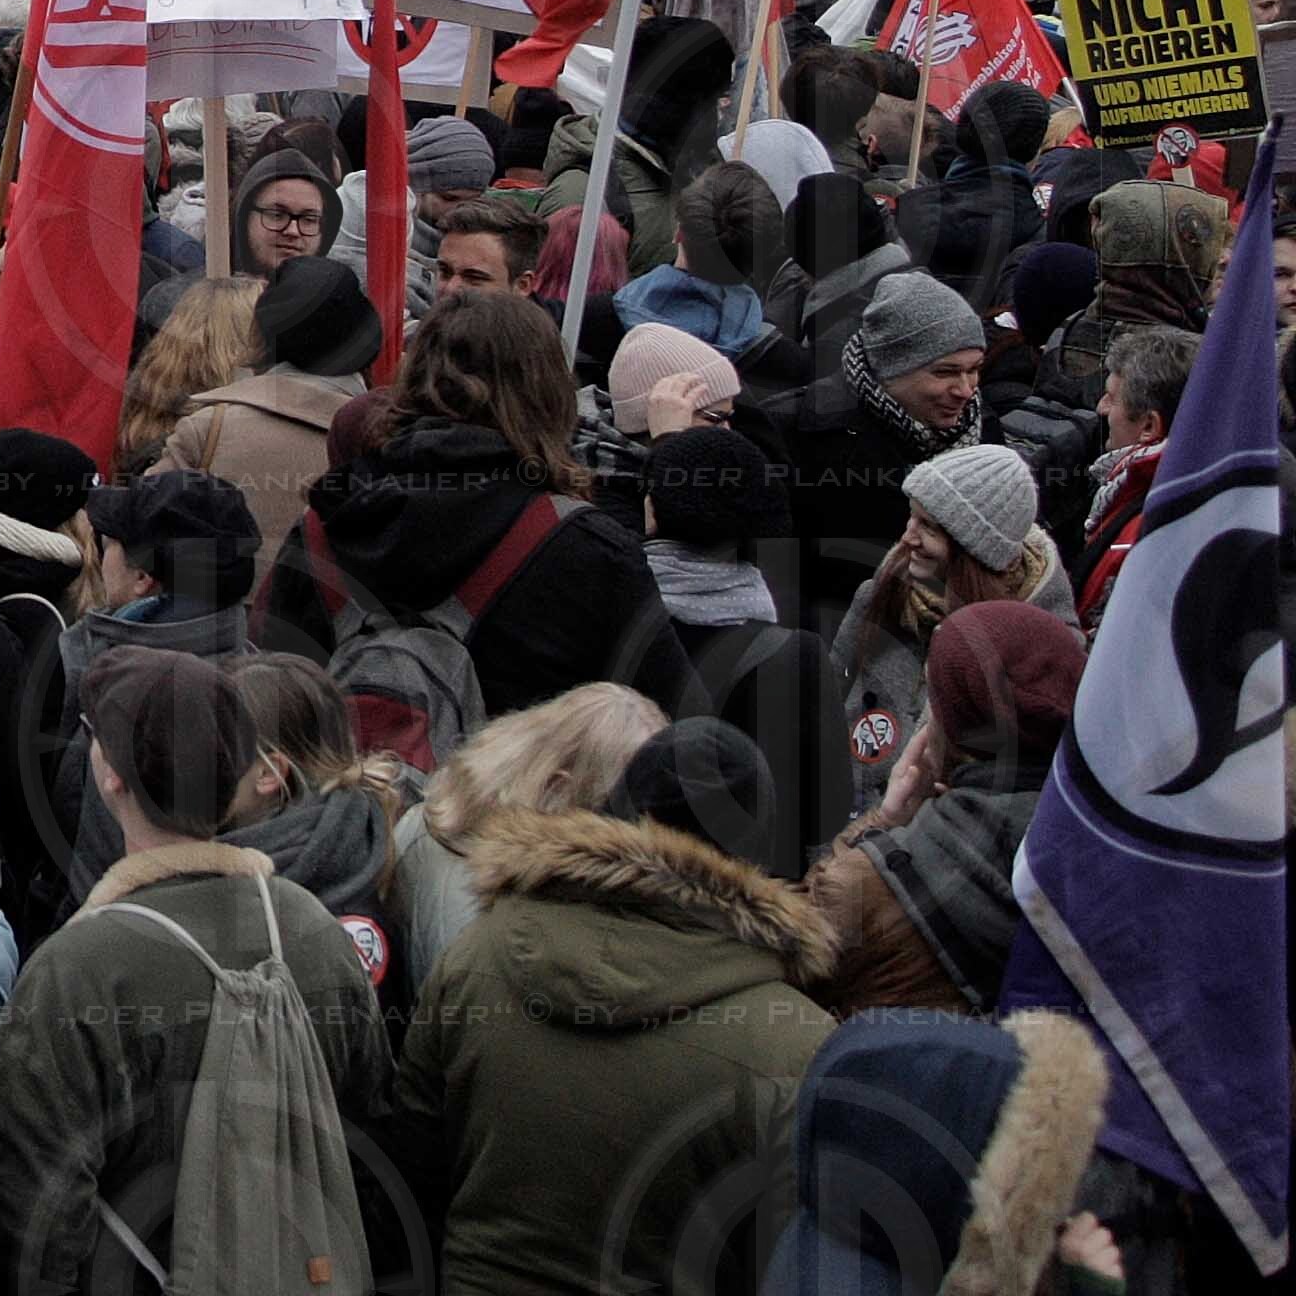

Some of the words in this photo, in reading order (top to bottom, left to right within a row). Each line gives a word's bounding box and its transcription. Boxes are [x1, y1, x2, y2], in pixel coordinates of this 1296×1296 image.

[1085, 22, 1238, 73] REGIEREN
[1092, 79, 1141, 107] UND
[1142, 65, 1245, 101] NIEMALS
[1099, 91, 1251, 127] AUFMARSCHIEREN!
